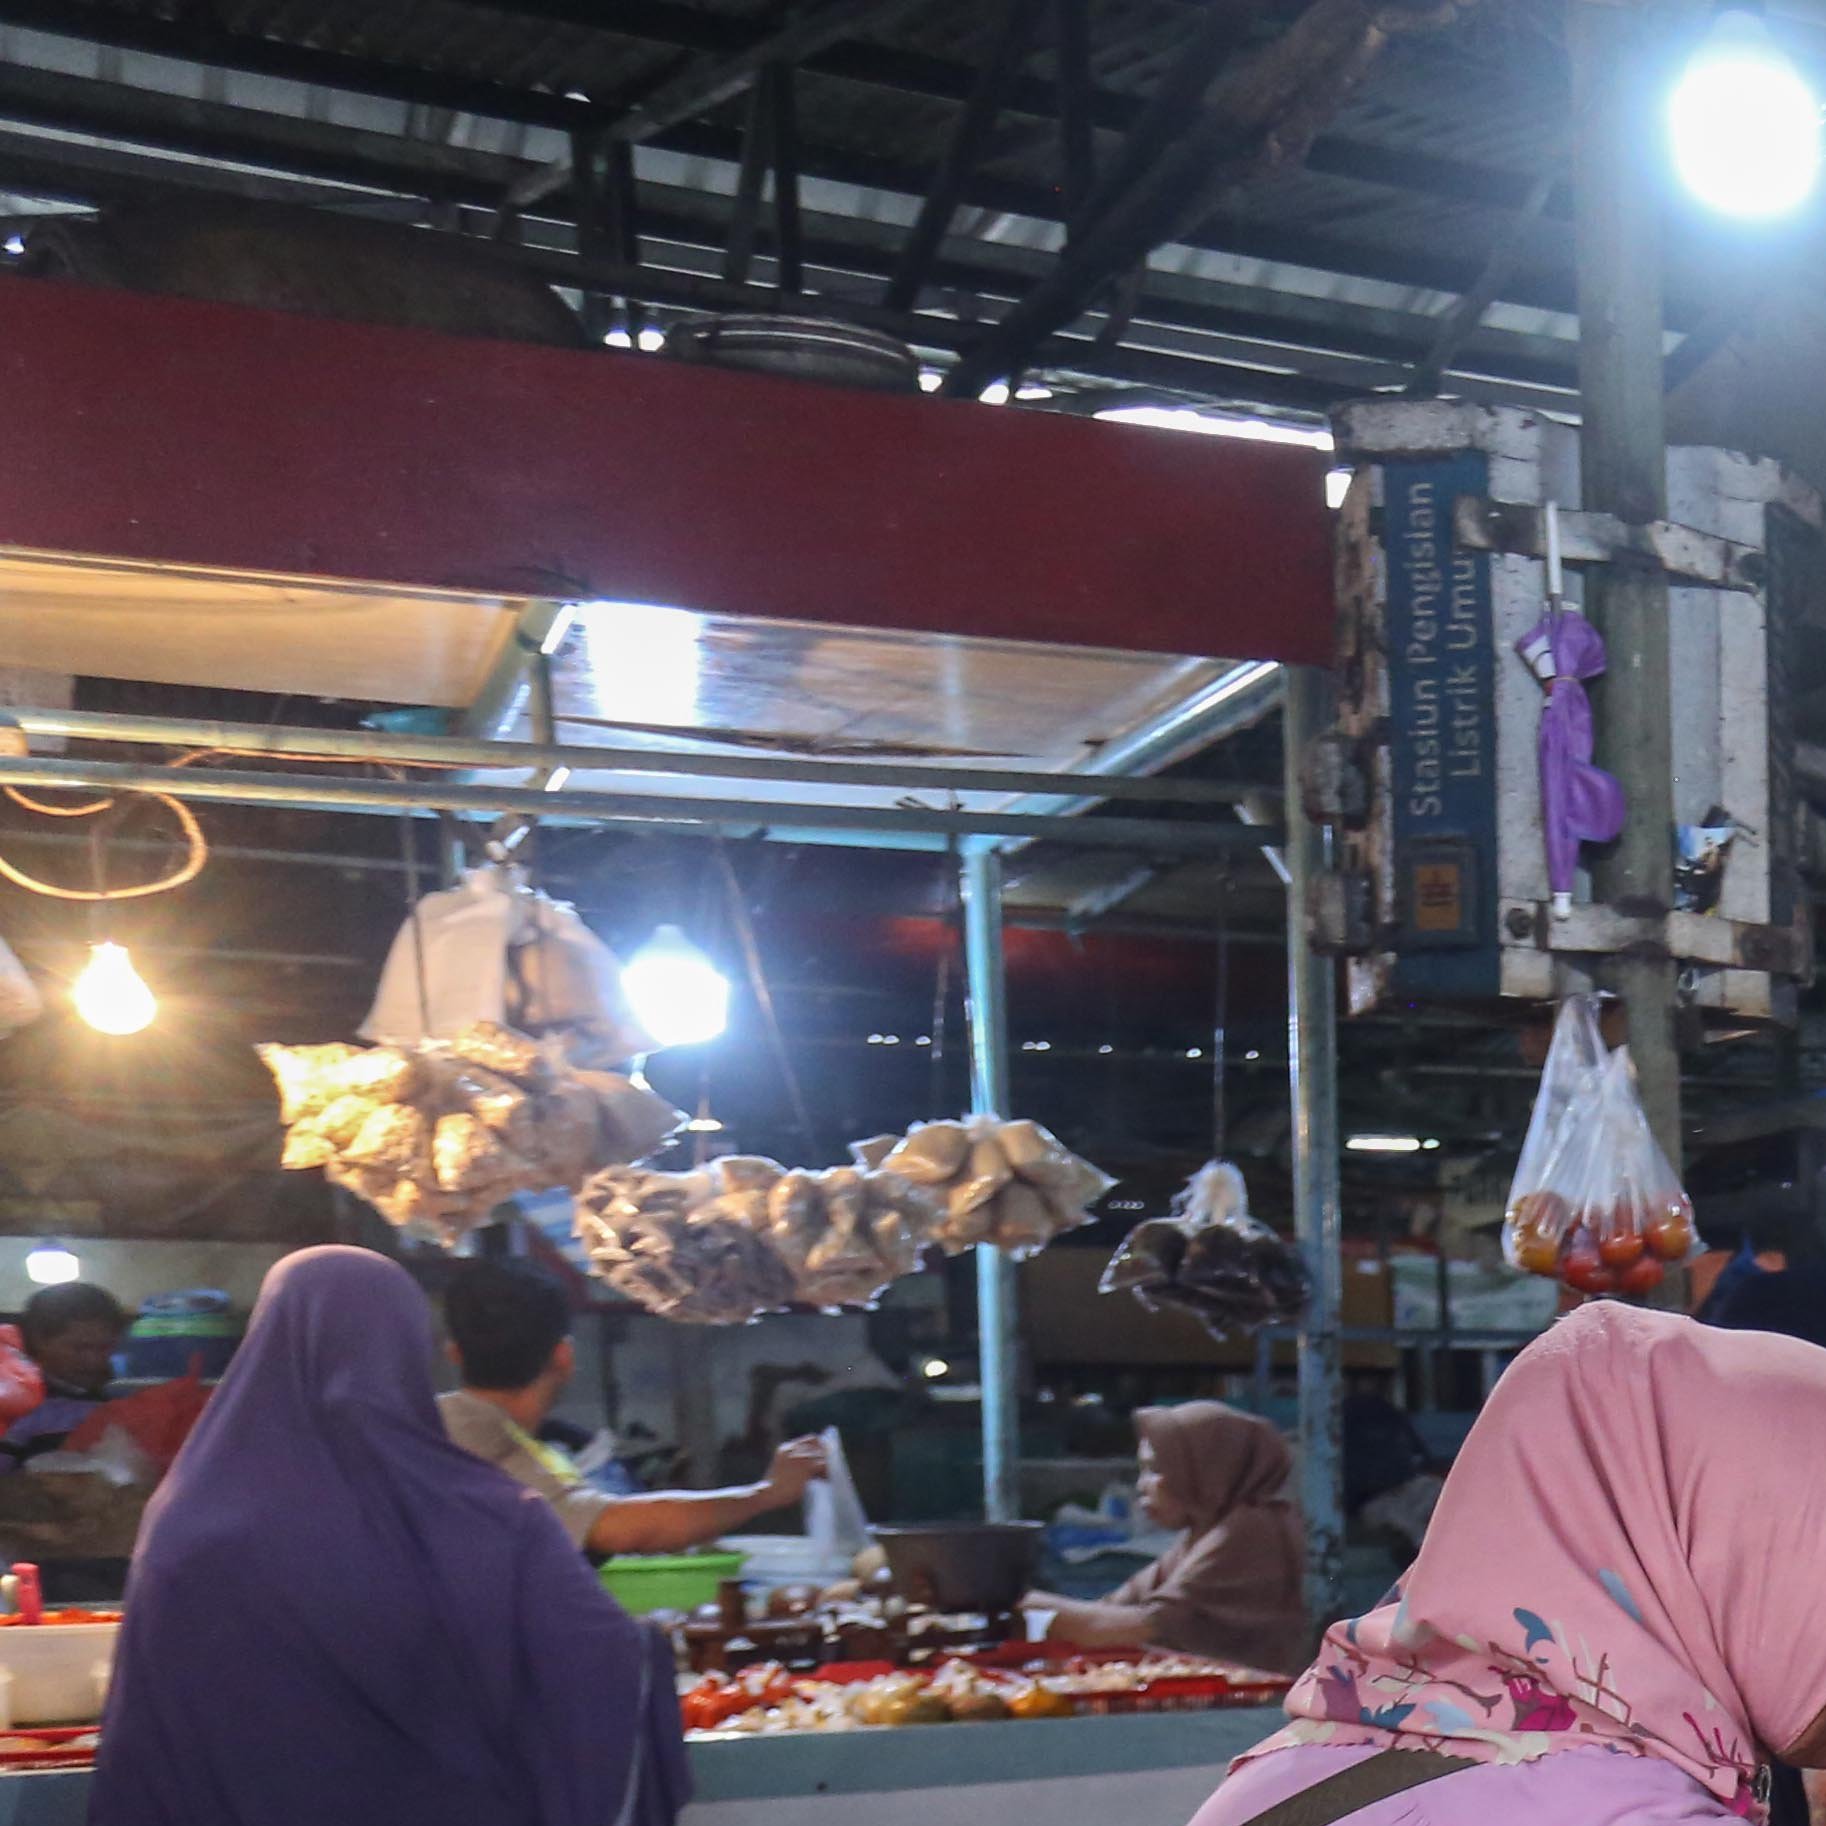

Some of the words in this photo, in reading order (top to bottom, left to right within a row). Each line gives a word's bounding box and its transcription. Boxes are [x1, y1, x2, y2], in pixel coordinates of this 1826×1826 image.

[1402, 482, 1443, 664] Pengisian
[1446, 547, 1478, 651] Umu
[1408, 678, 1442, 817] Stasiun
[1445, 664, 1482, 777] Listrik
